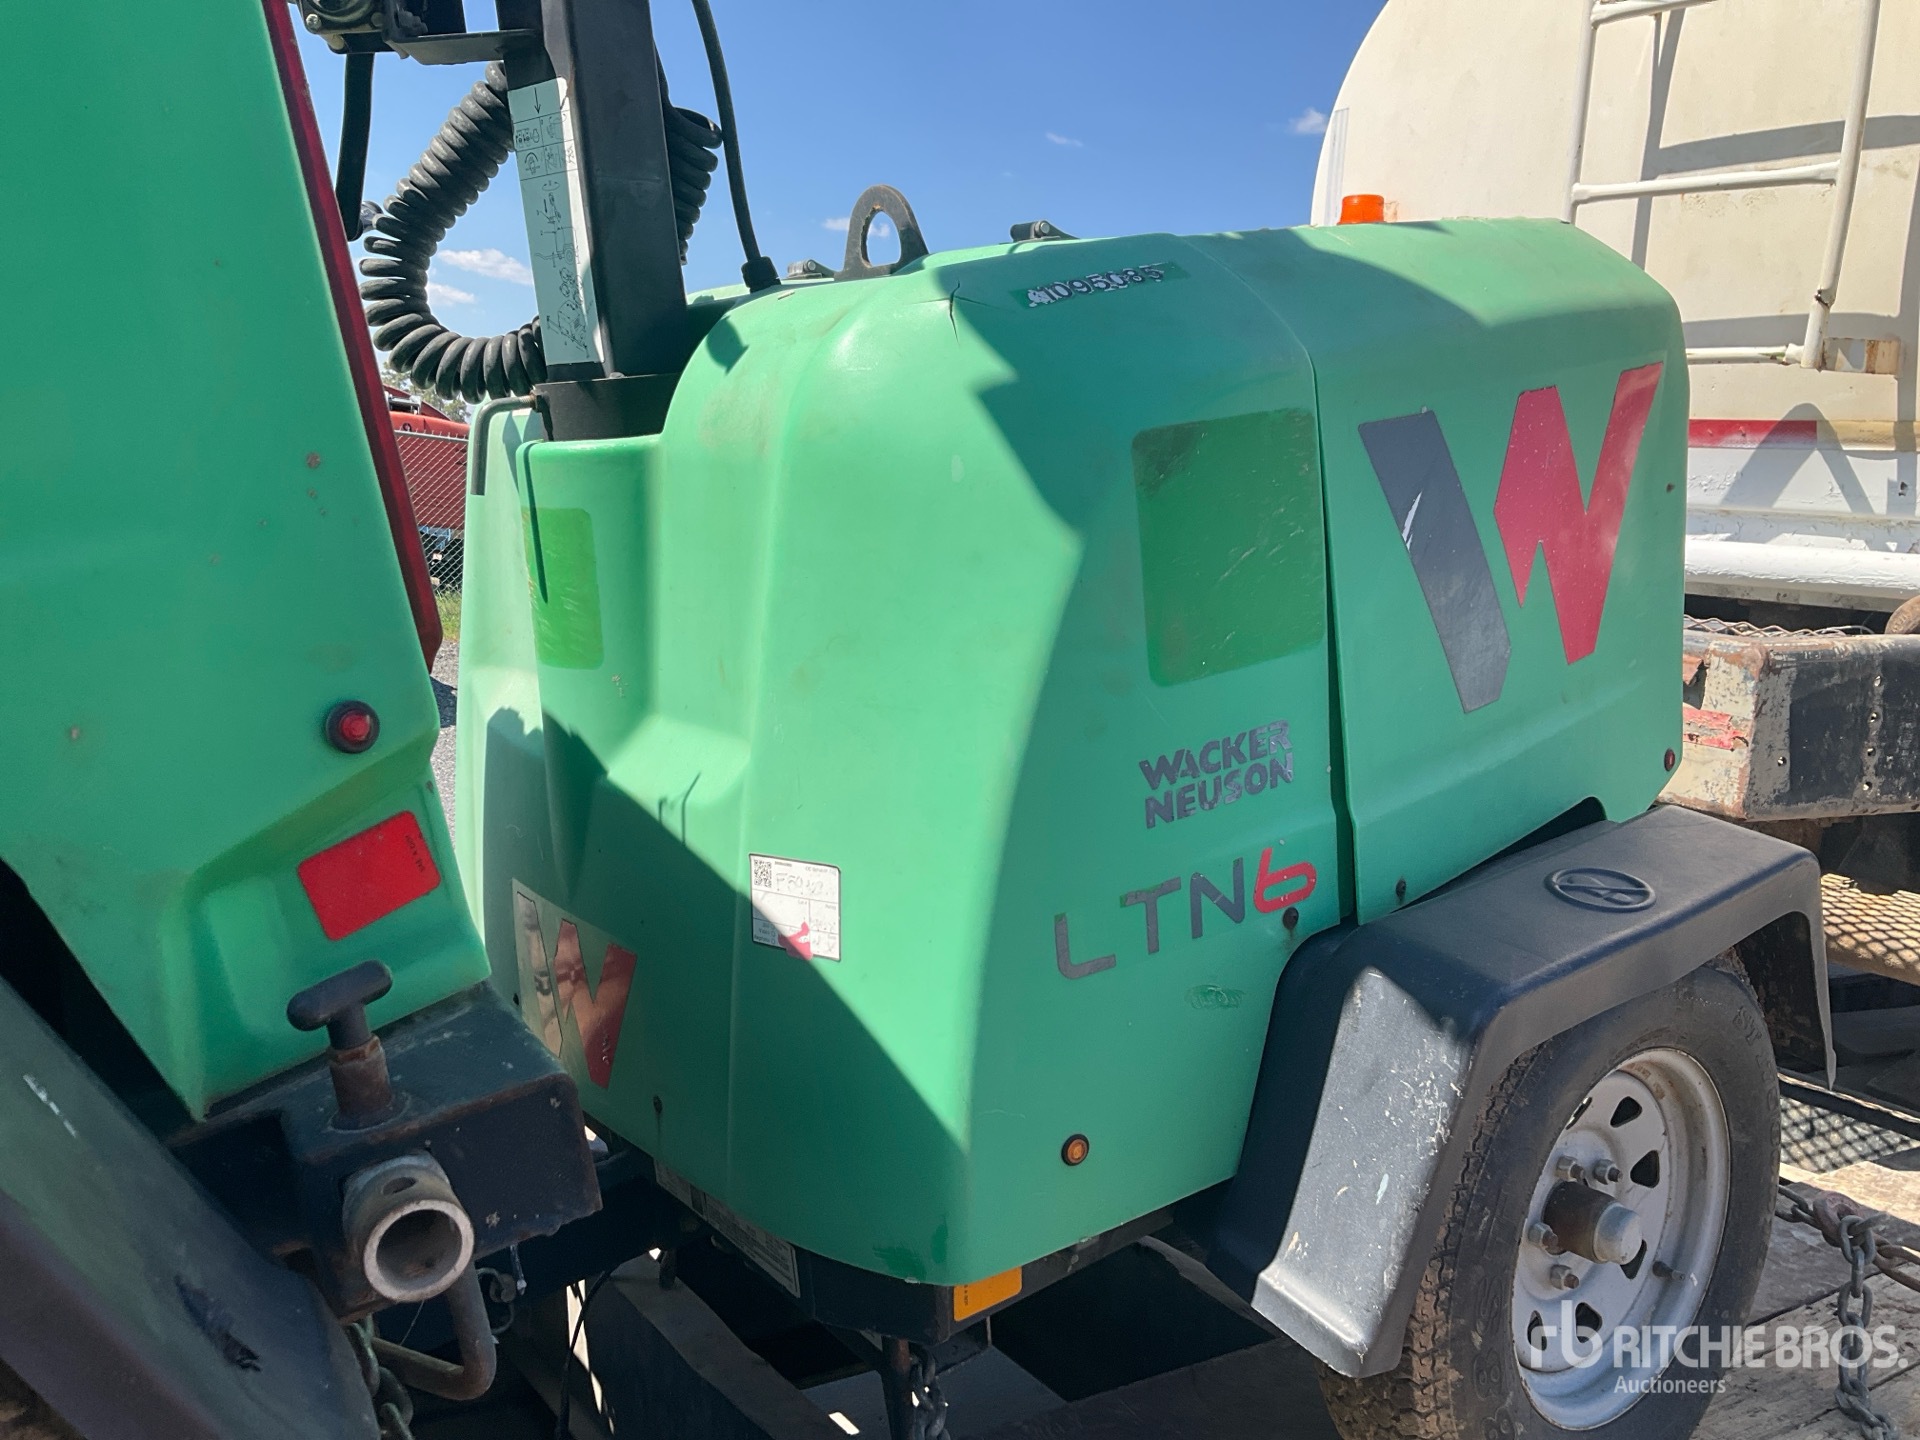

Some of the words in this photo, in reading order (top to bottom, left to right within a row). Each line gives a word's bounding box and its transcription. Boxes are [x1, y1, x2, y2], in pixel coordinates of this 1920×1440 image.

[1139, 719, 1294, 790] WACKER
[1145, 752, 1294, 829] NEUSON
[1054, 847, 1317, 980] LTN6
